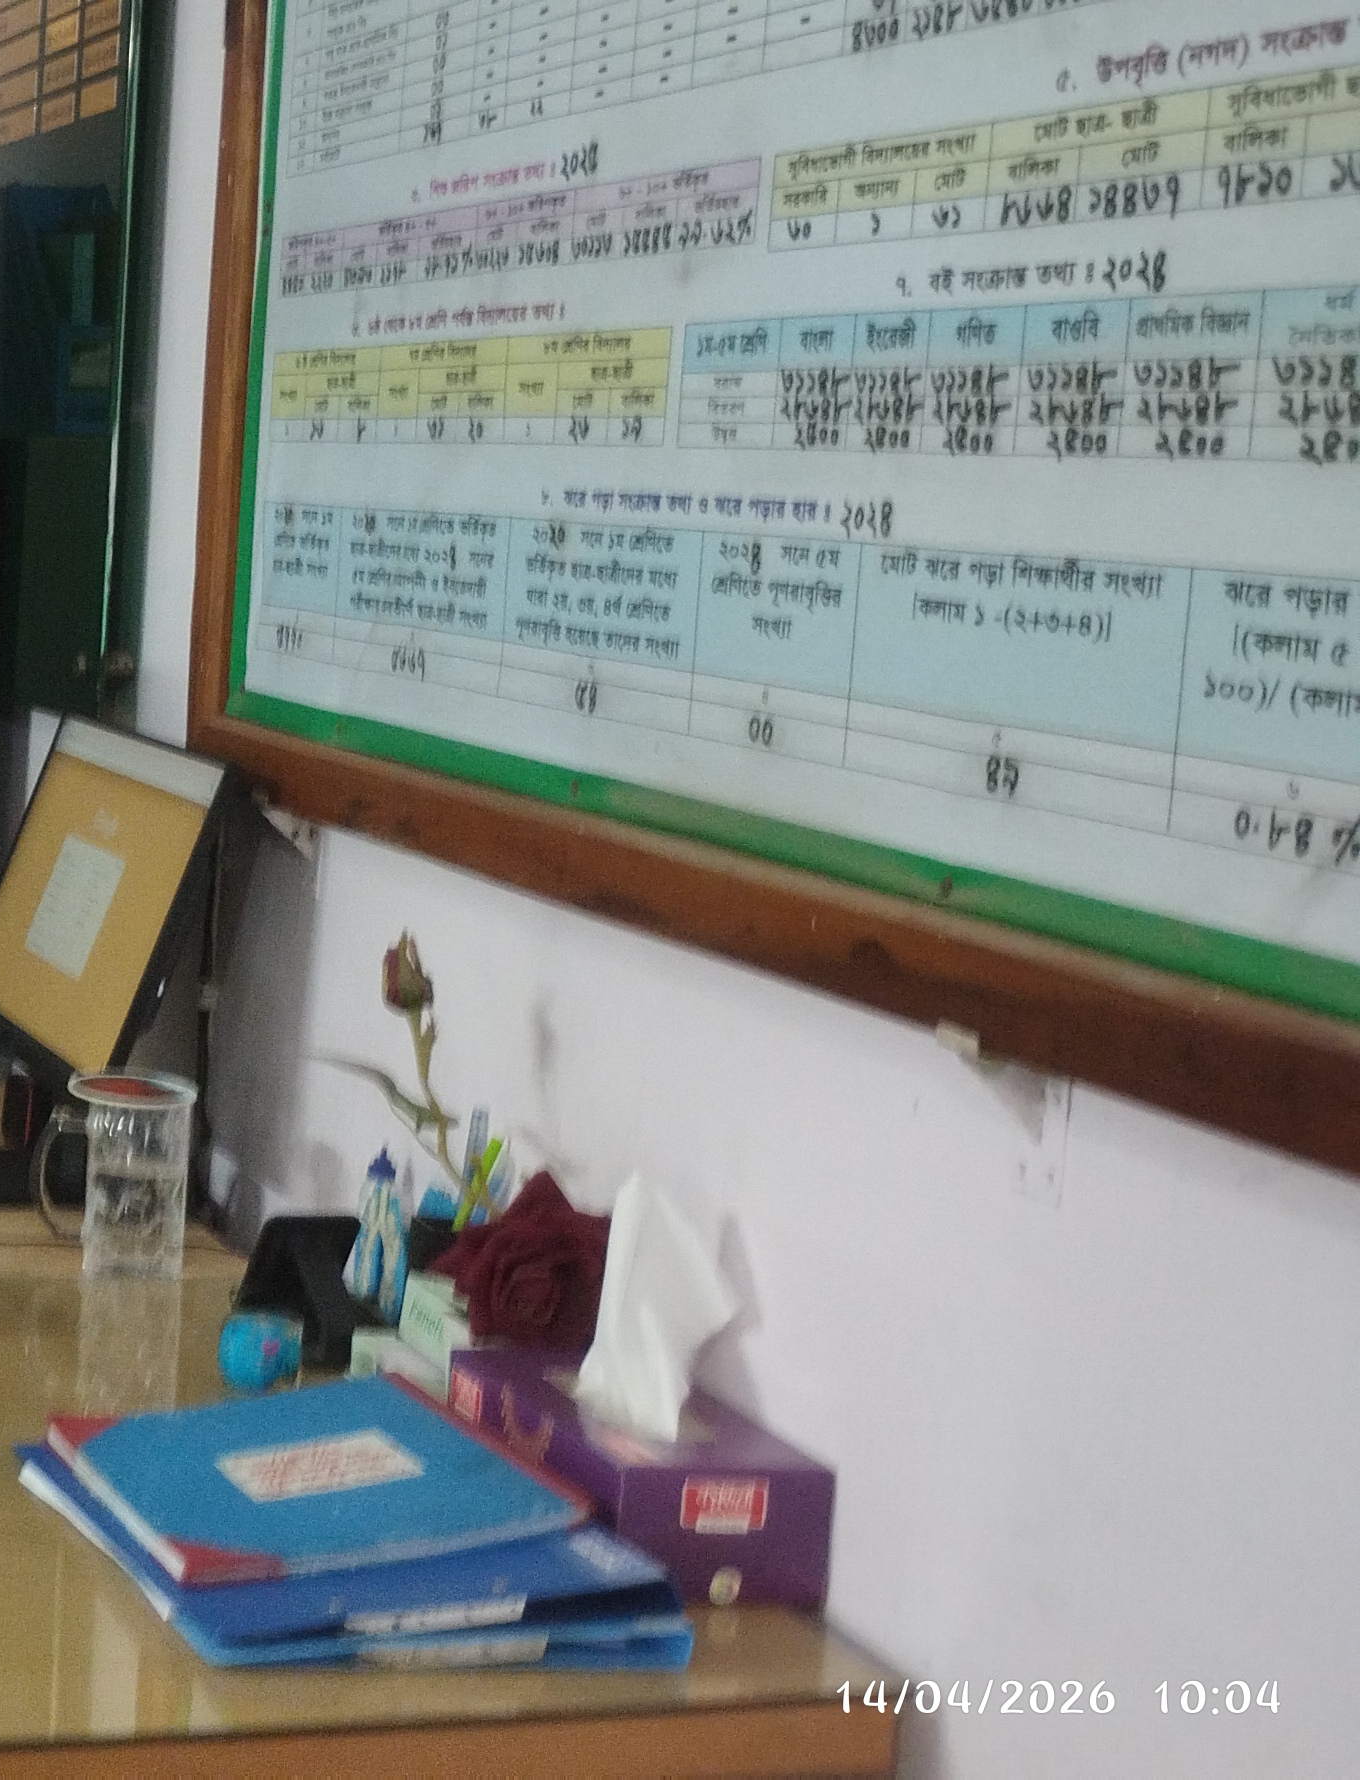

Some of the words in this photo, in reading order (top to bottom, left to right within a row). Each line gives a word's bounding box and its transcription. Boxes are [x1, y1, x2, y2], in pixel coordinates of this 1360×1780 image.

[961, 265, 1030, 294] সংক্রান্ত
[1035, 261, 1078, 286] তথ্য
[1102, 250, 1167, 292] ২০২৪
[799, 328, 834, 353] বাংলা
[1133, 356, 1241, 392] ৩১১৪৮
[881, 549, 918, 576] মোট
[925, 556, 961, 582] ঝরে
[969, 560, 1004, 590] পড়া
[1012, 554, 1097, 594] শিক্ষার্থীর
[1103, 569, 1163, 601] সংখ্যা
[1223, 580, 1273, 610] ঝরে
[1283, 584, 1351, 620] পড়ার
[751, 614, 793, 641] সংখ্যা
